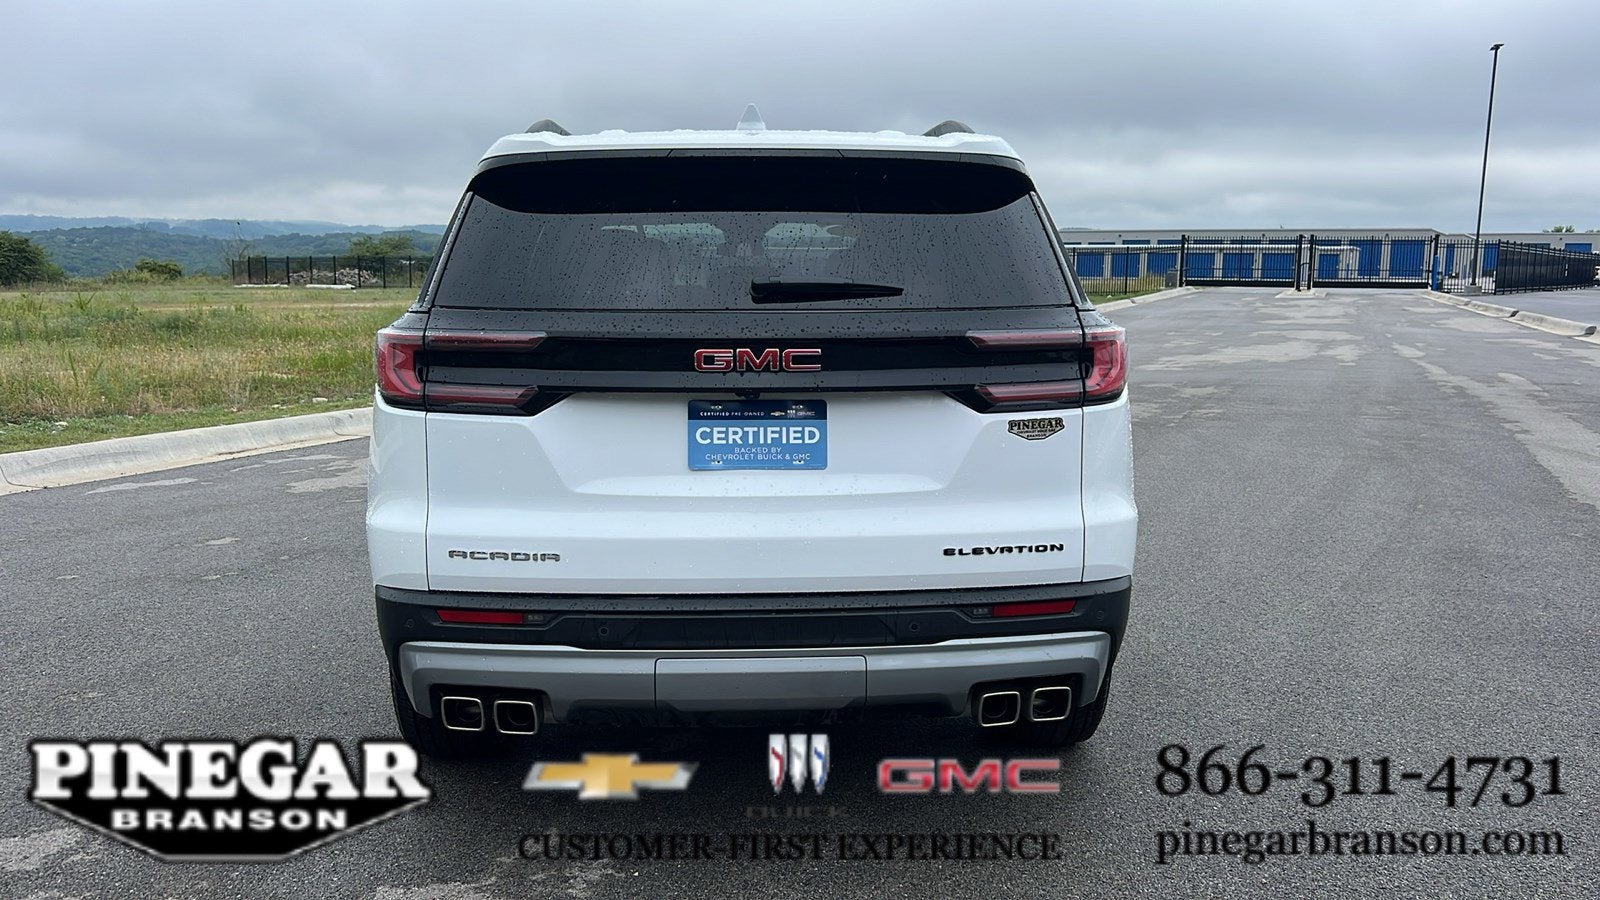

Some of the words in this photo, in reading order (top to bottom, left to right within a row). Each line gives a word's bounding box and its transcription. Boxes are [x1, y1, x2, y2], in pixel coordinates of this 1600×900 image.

[694, 348, 822, 372] GMC
[1010, 419, 1063, 430] PINEGAR
[695, 426, 821, 445] CERTIFIED
[705, 453, 755, 461] CHEVROLET
[943, 543, 1064, 556] ELEVATION
[448, 550, 561, 562] ACADIA
